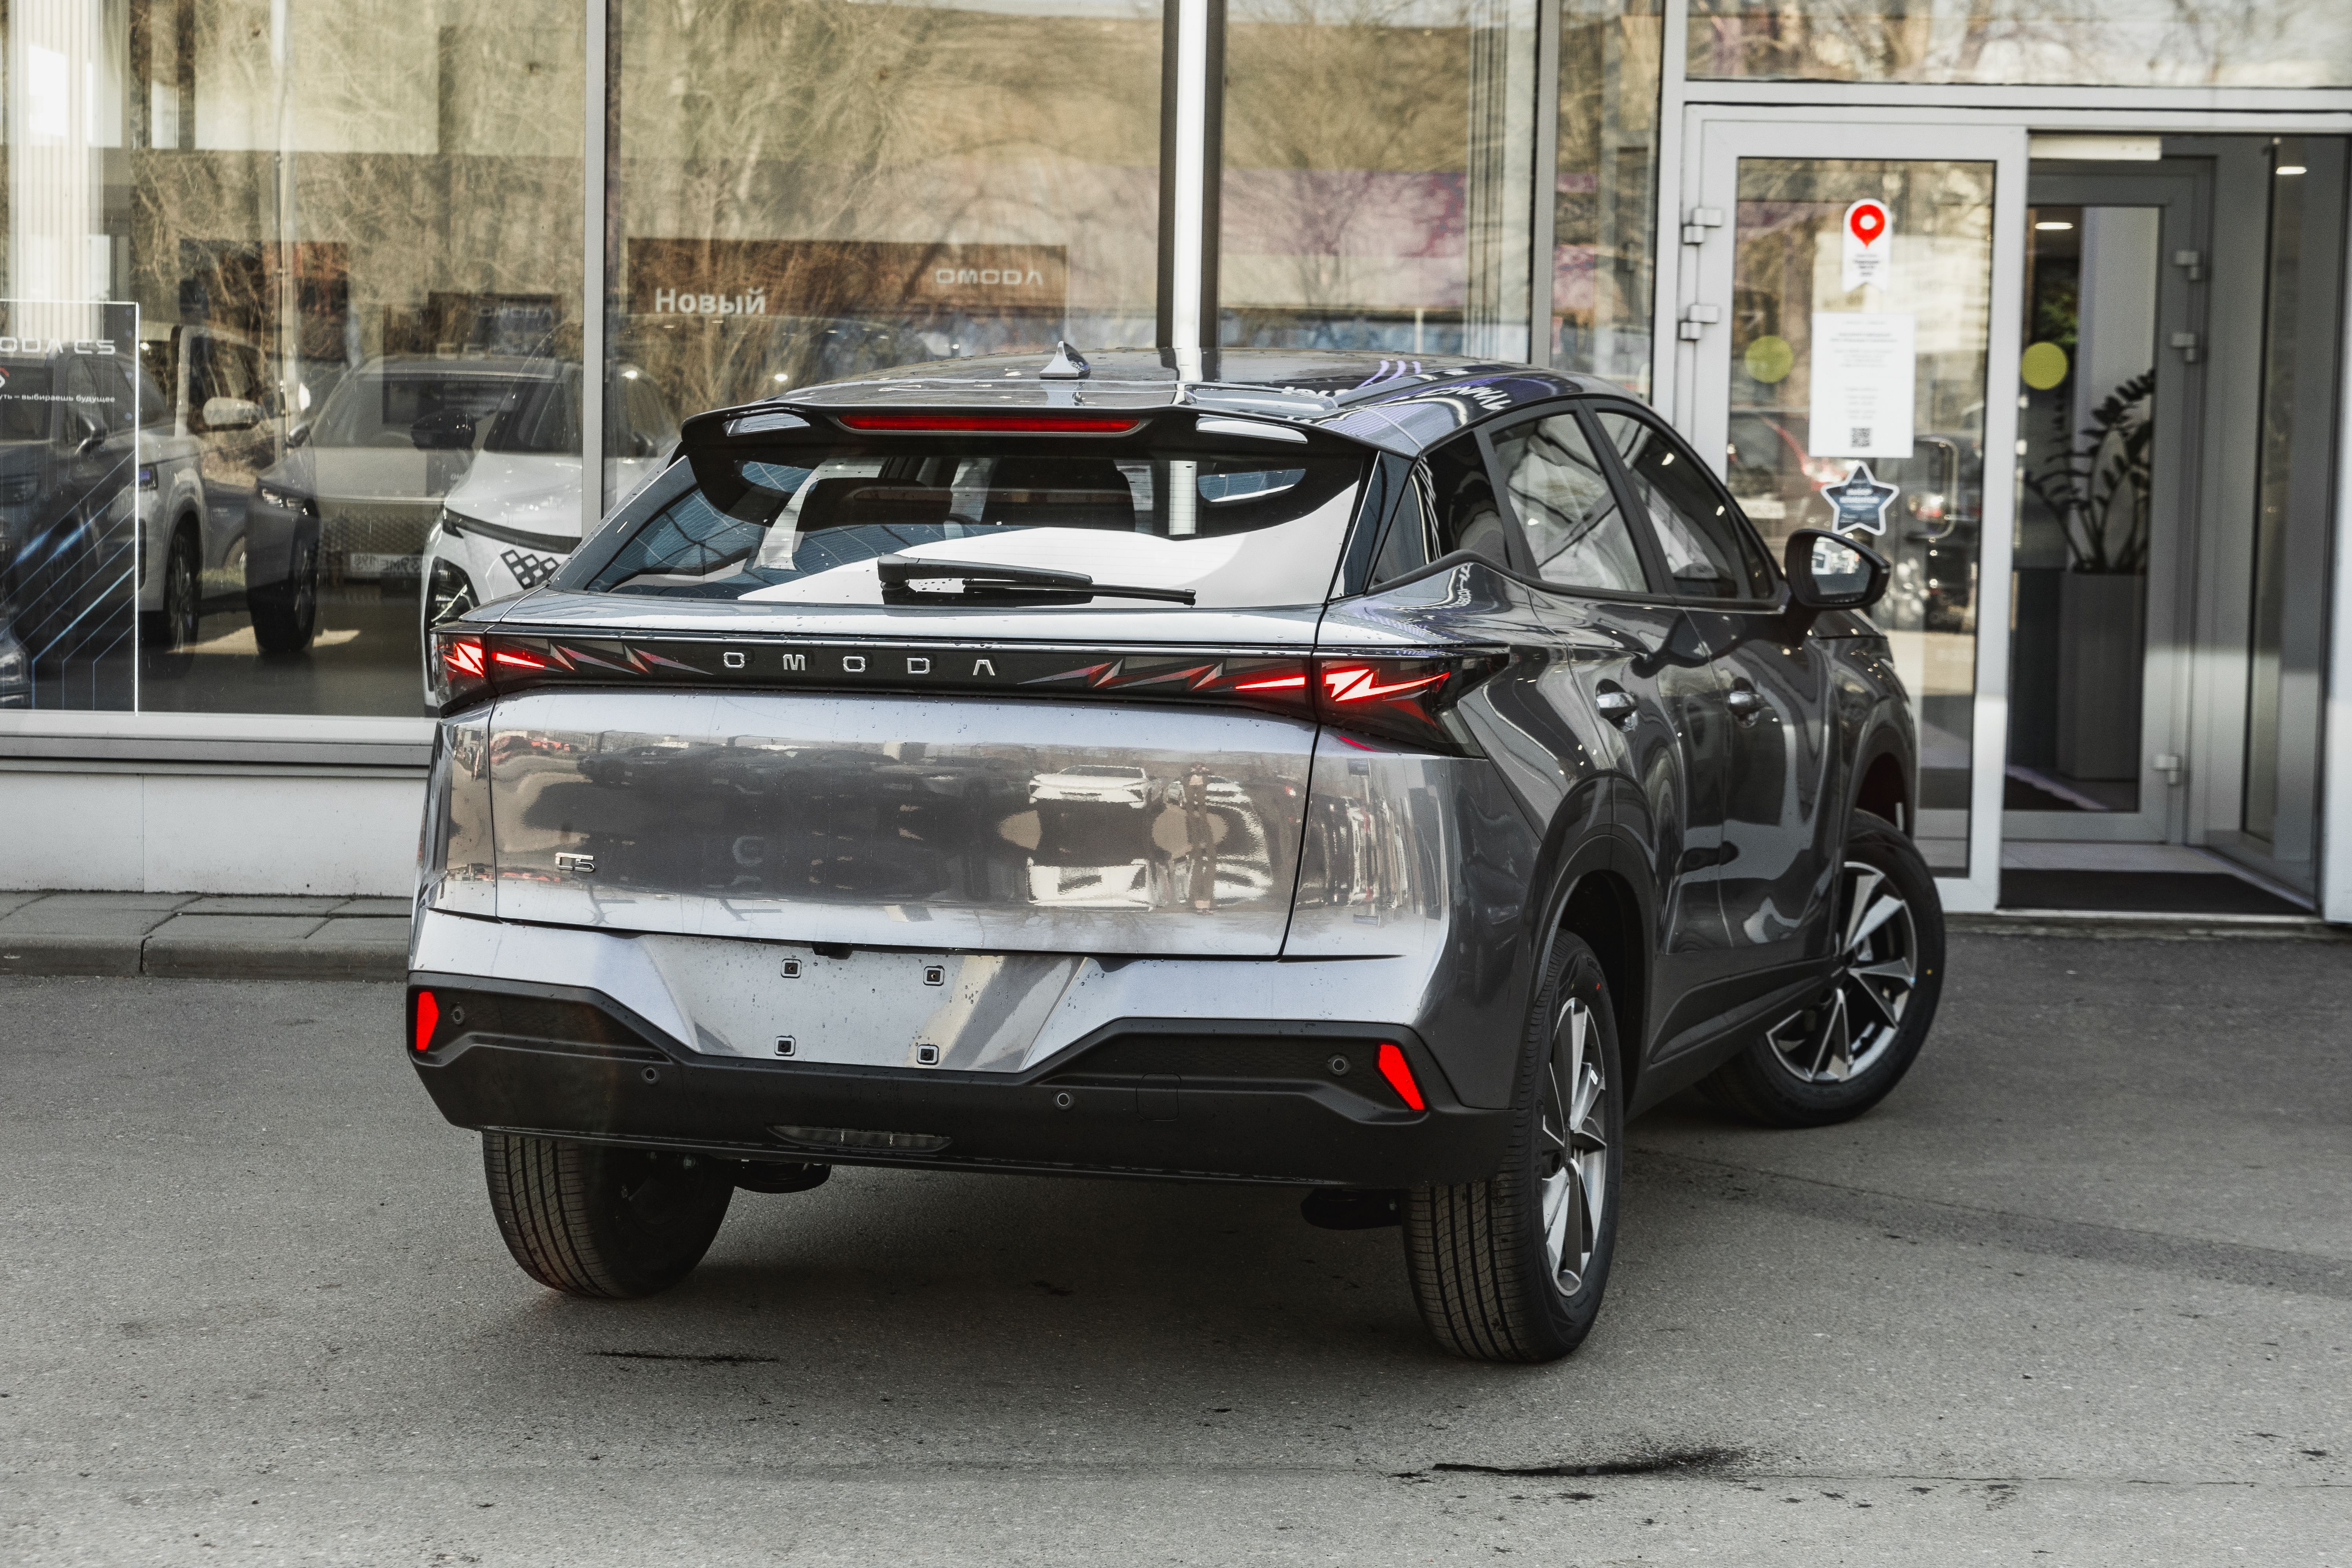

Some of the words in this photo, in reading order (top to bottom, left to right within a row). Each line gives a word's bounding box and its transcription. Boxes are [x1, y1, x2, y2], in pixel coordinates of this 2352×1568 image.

[936, 269, 1044, 285] OMODA
[655, 287, 766, 314] Новый
[22, 394, 74, 402] выбираешь
[76, 394, 115, 403] будущее
[724, 652, 995, 676] OMODA
[555, 852, 594, 872] C5
